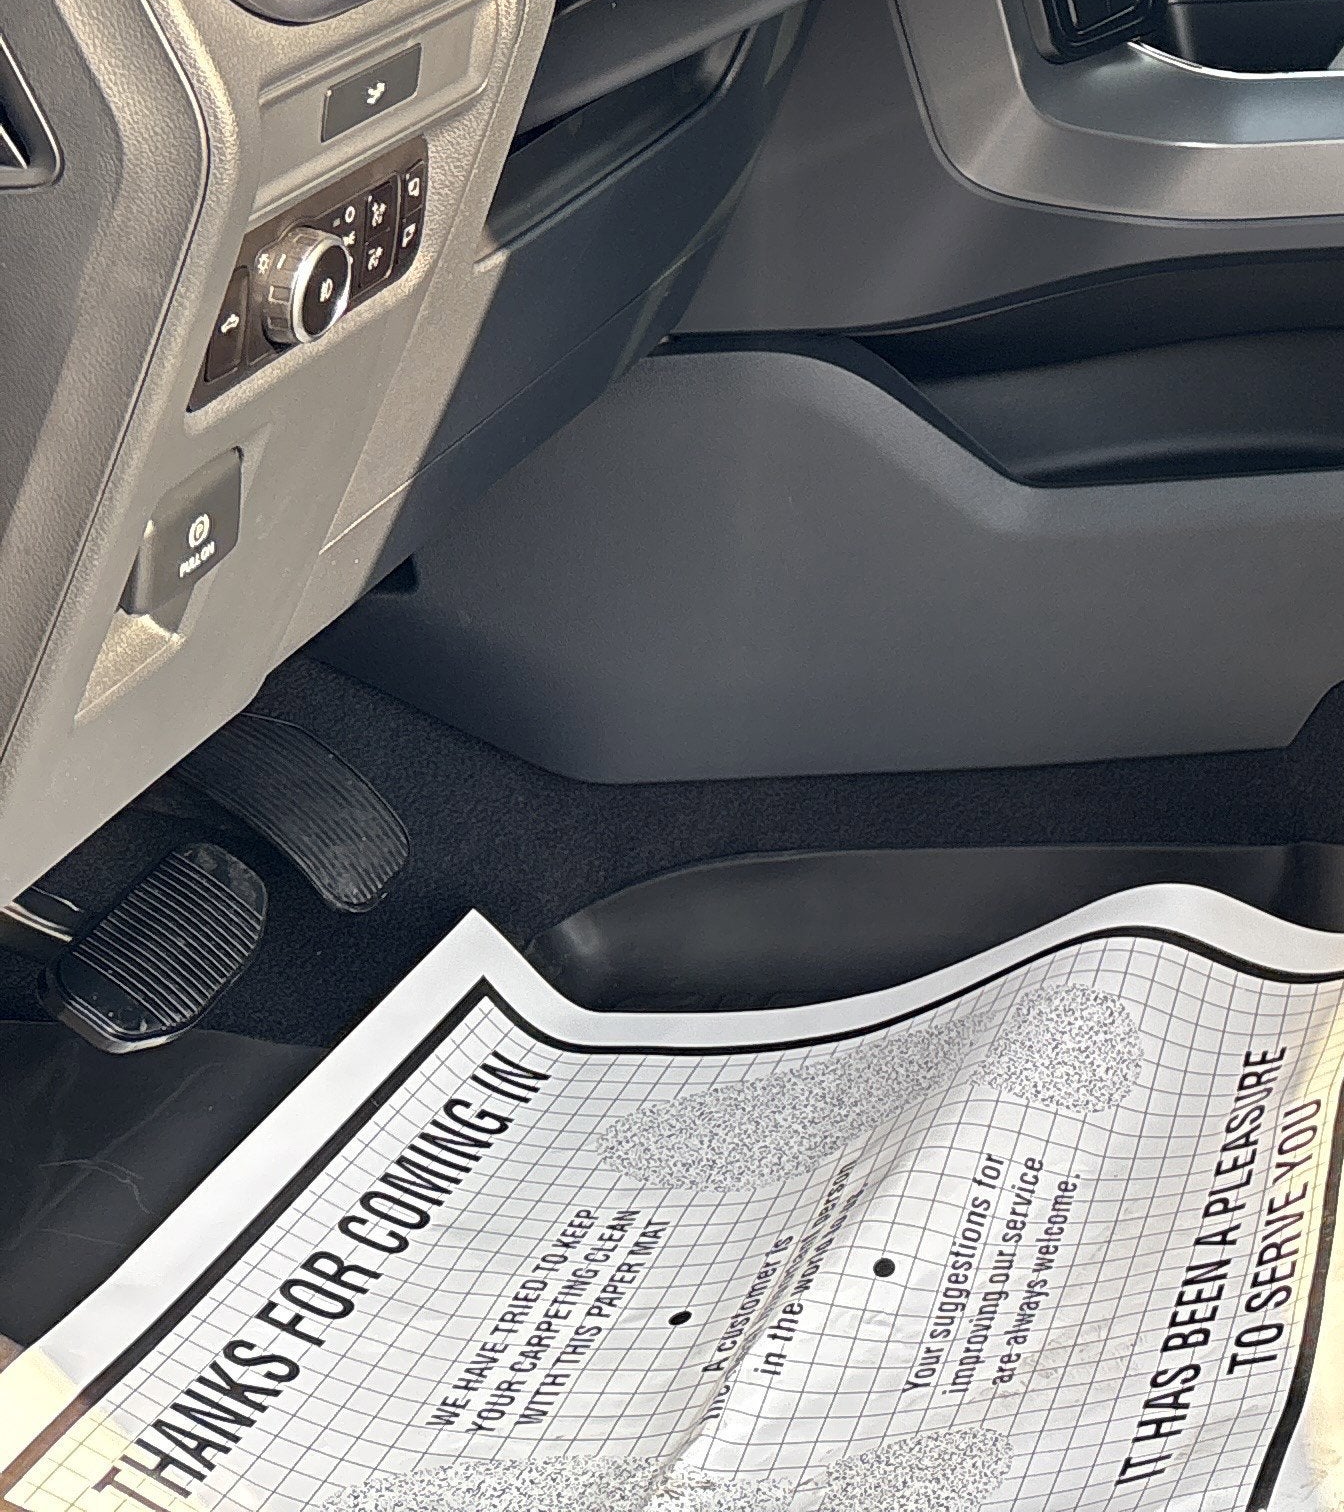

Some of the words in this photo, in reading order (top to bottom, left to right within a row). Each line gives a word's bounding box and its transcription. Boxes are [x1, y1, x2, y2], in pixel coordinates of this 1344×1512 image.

[1201, 1045, 1288, 1221] PLEASURE
[1270, 1097, 1323, 1180] YOU
[1001, 1156, 1044, 1244] service
[1031, 1173, 1082, 1274] welcome.
[1193, 1222, 1244, 1247] A
[95, 1339, 301, 1512] THANKS
[255, 1250, 384, 1348] FOR
[338, 1098, 514, 1255] COMING
[470, 1050, 552, 1104] IN
[902, 1345, 945, 1394] Your
[929, 1195, 992, 1340] suggestions
[972, 1152, 1005, 1190] for
[989, 1248, 1017, 1284] our
[1243, 1180, 1311, 1316] SERVE
[425, 1395, 471, 1427] WE
[452, 1340, 510, 1392] HAVE
[489, 1278, 550, 1337] TRIED
[531, 1253, 569, 1274] TO
[552, 1208, 600, 1249] KEEP
[464, 1378, 528, 1434] YOUR
[509, 1267, 601, 1373] CARPETING
[583, 1209, 642, 1264] CLEAN
[513, 1372, 572, 1427] WITH
[552, 1324, 604, 1368] THIS
[584, 1261, 647, 1319] PAPER
[627, 1217, 672, 1257] MAT
[702, 1354, 730, 1374] A
[716, 1259, 783, 1355] customer
[765, 1234, 794, 1258] is
[766, 1300, 805, 1342] the
[941, 1289, 1010, 1396] improving
[1003, 1277, 1050, 1347] always
[1160, 1257, 1233, 1355] BEEN
[1226, 1320, 1286, 1376] TO
[753, 1350, 788, 1376] in
[992, 1351, 1022, 1386] are
[1131, 1362, 1203, 1446] HAS
[1115, 1451, 1173, 1486] IT
